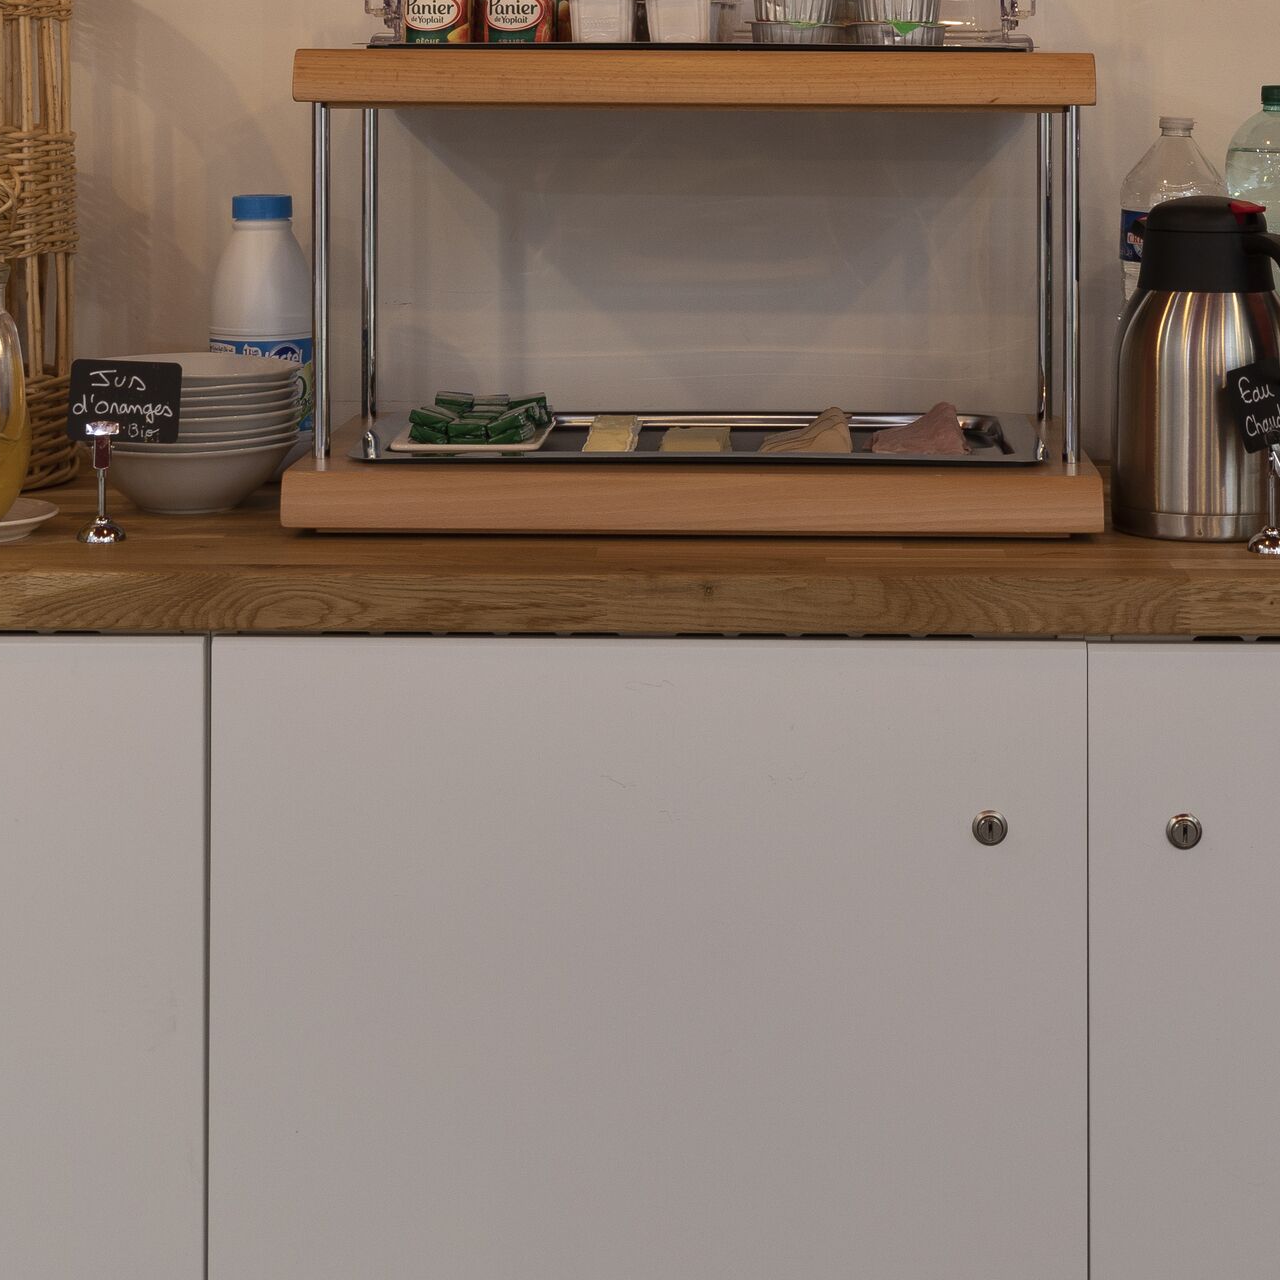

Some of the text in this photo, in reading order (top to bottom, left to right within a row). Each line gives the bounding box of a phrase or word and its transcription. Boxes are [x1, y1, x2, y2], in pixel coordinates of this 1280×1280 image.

[417, 16, 444, 25] Yoplait
[500, 16, 528, 25] Yoplait
[89, 370, 146, 391] Jus
[1238, 376, 1275, 404] Eau
[127, 423, 160, 438] Bio
